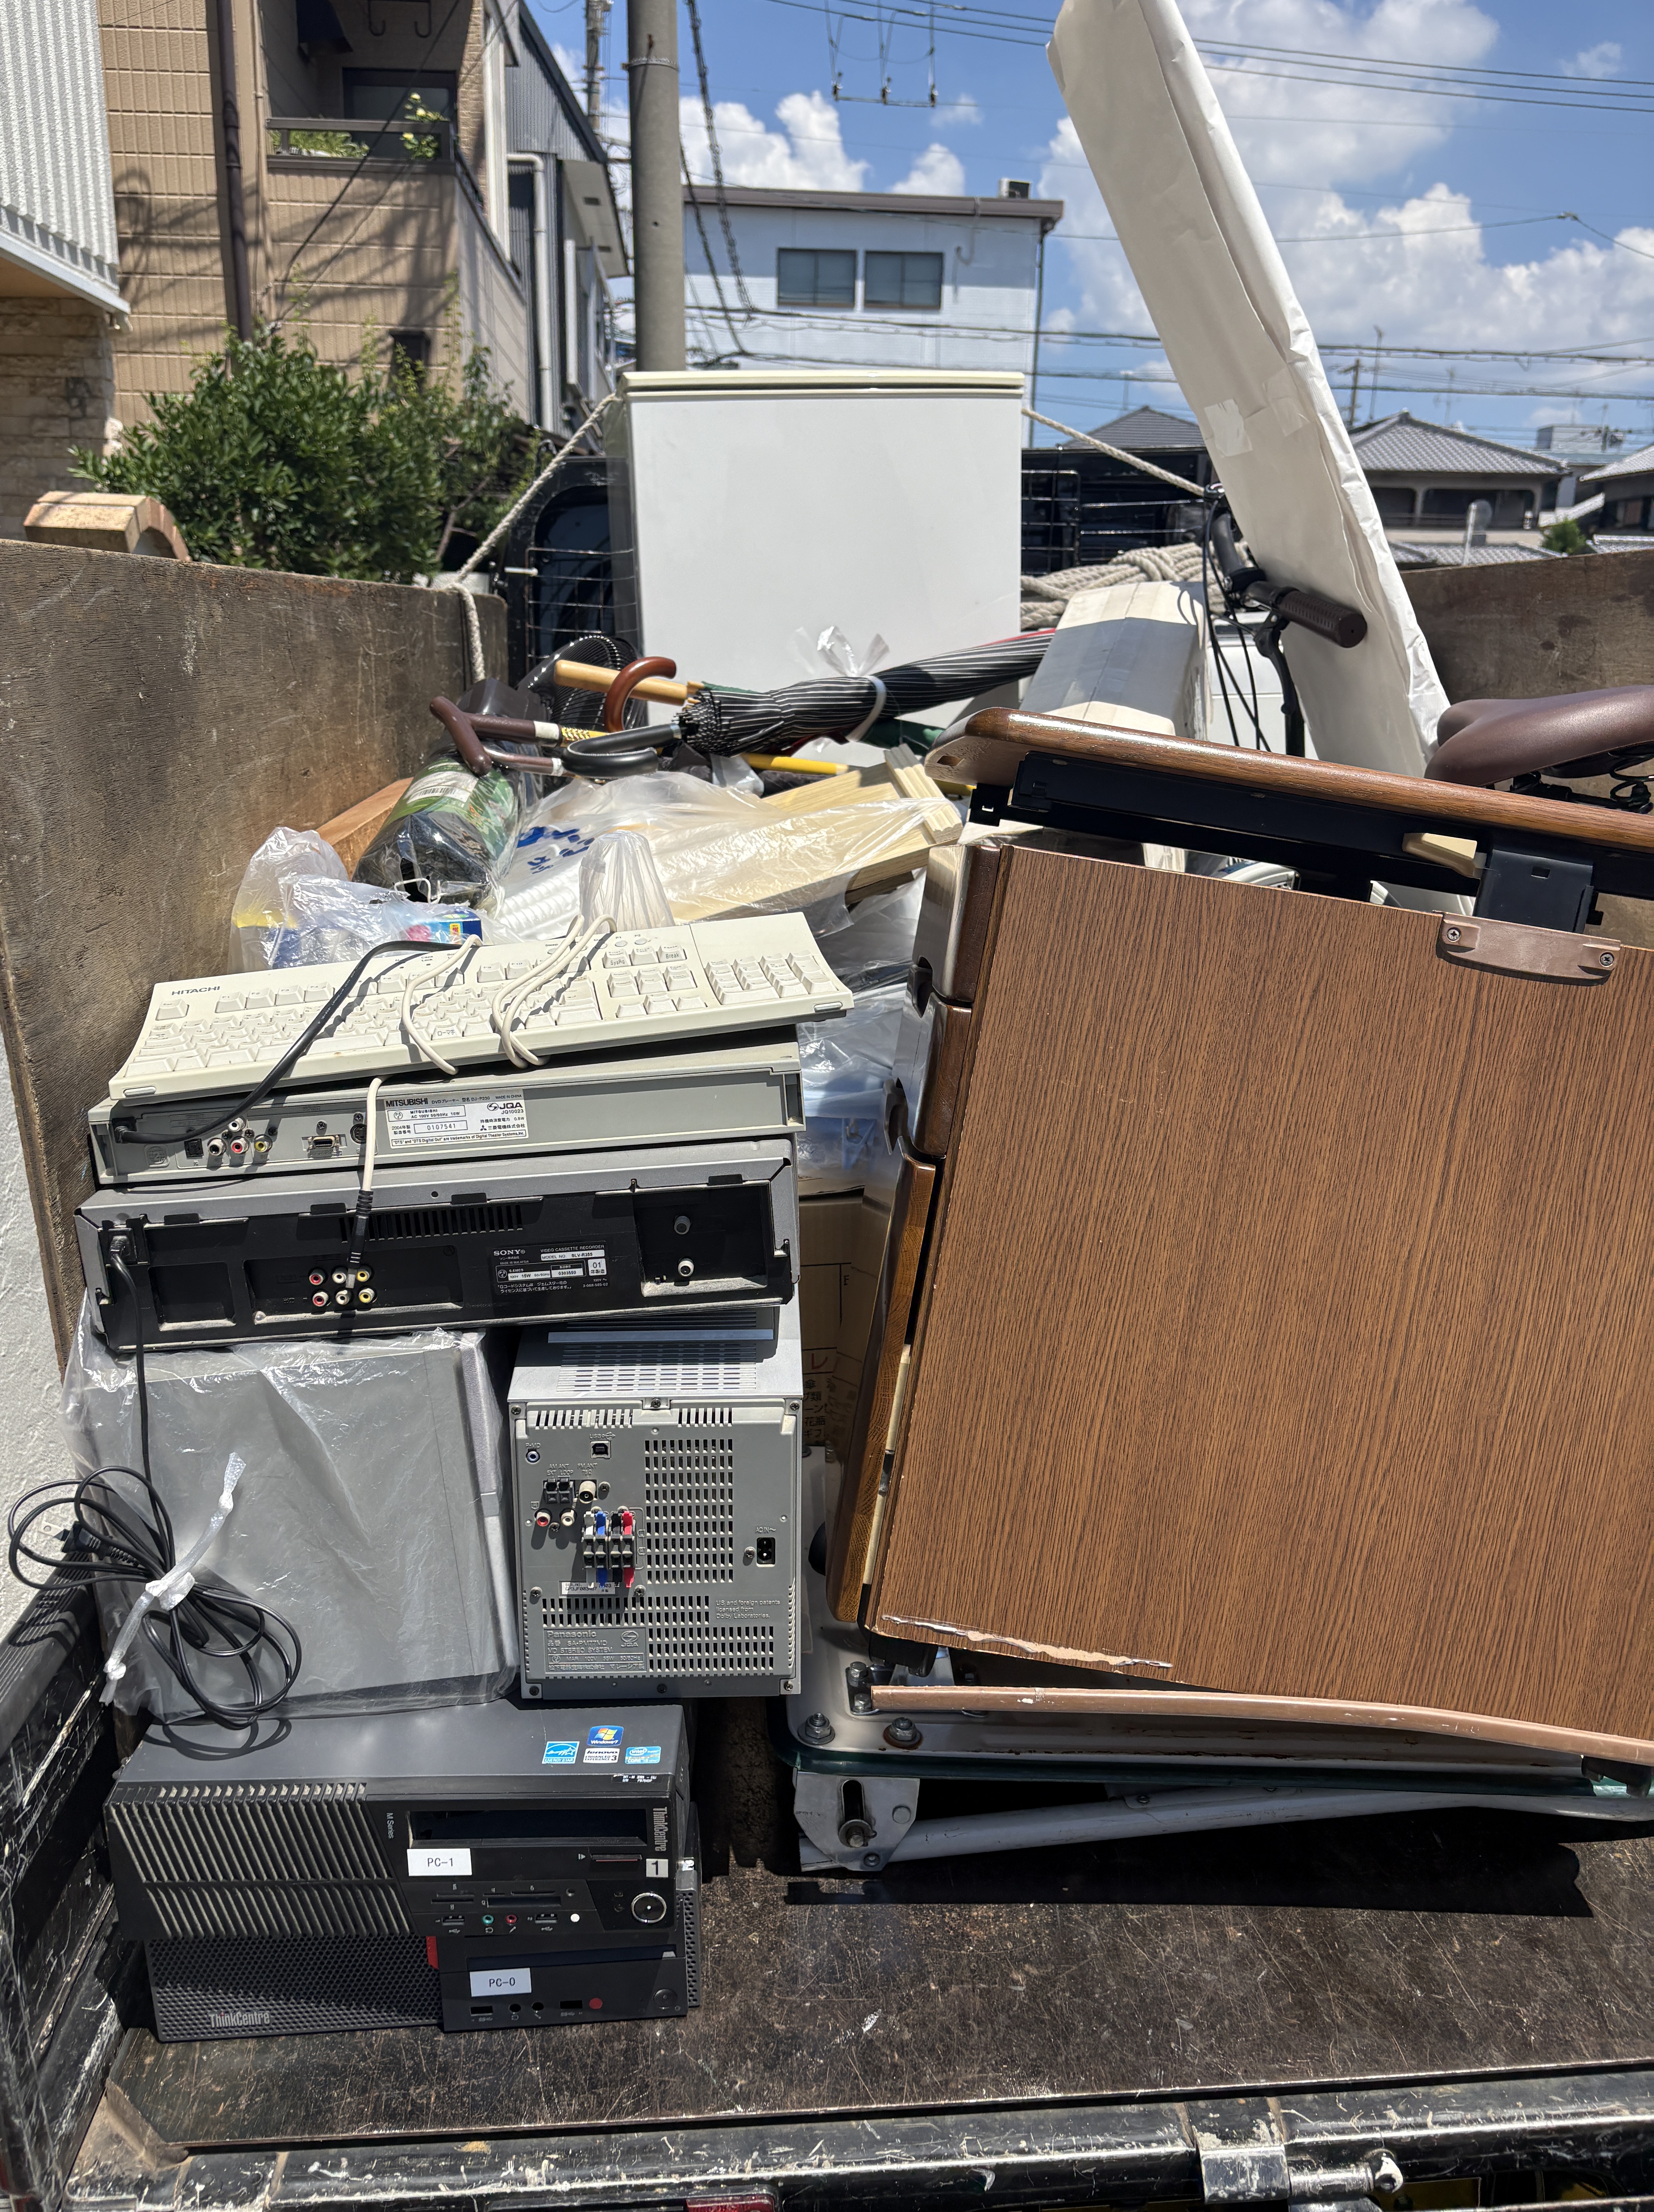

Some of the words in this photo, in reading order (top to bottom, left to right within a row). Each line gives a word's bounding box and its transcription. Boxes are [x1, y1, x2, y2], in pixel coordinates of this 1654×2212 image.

[172, 986, 220, 996] HITACHI
[386, 1097, 428, 1107] MITSUBISHI
[547, 1630, 597, 1638] Panasonic
[387, 1820, 395, 1839] Series
[653, 1807, 669, 1851] ThinkCentre
[427, 1857, 453, 1867] PC-1
[651, 1860, 659, 1876] 1
[488, 1977, 516, 1988] PC-0
[209, 2011, 270, 2028] ThinkCentre
